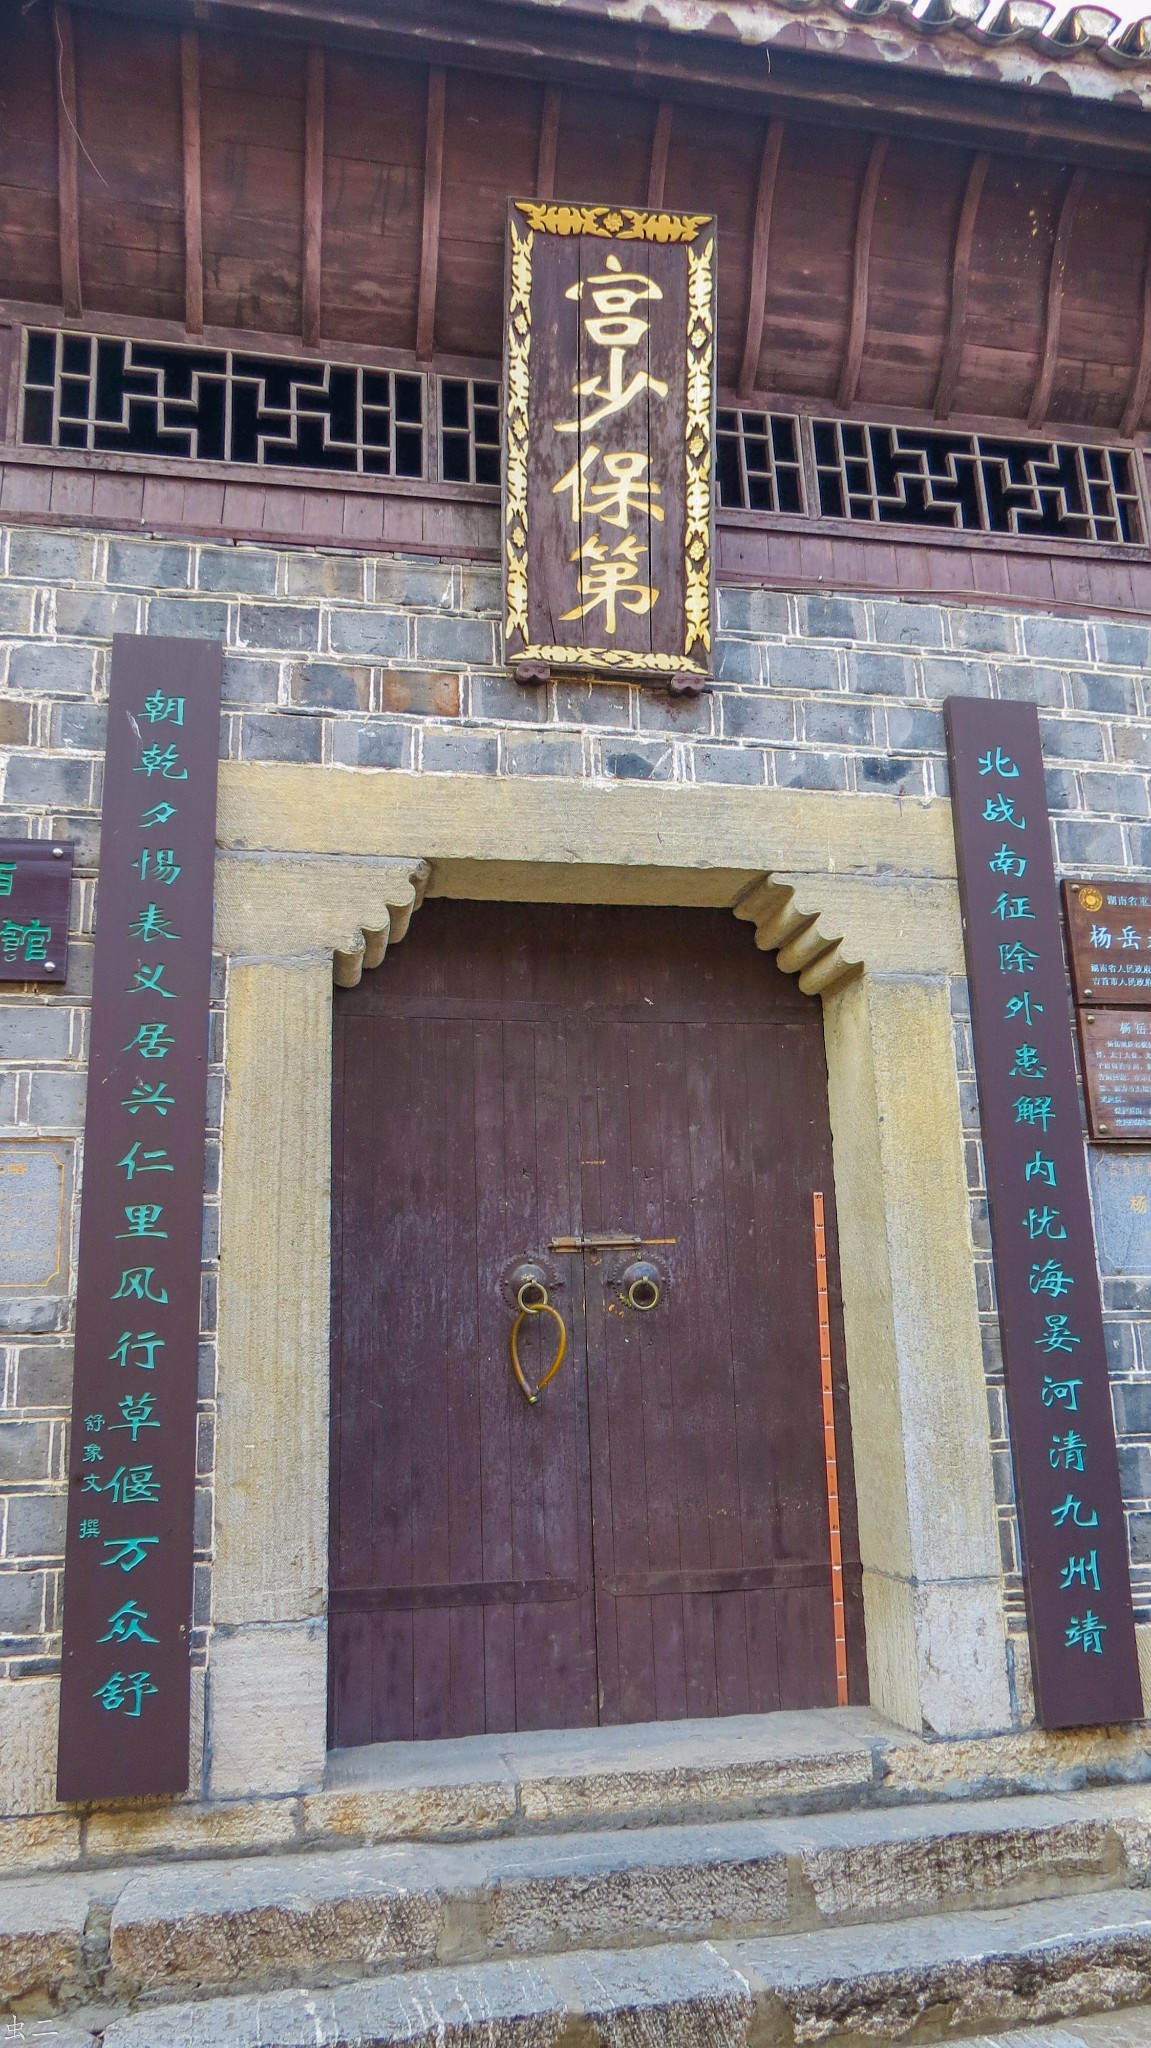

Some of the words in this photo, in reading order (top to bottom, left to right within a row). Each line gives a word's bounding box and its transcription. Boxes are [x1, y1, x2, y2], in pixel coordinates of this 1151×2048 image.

[1089, 923, 1151, 950] 杨岳
[977, 746, 1107, 1654] 北战南征除外患解内忧海晏河清九州靖
